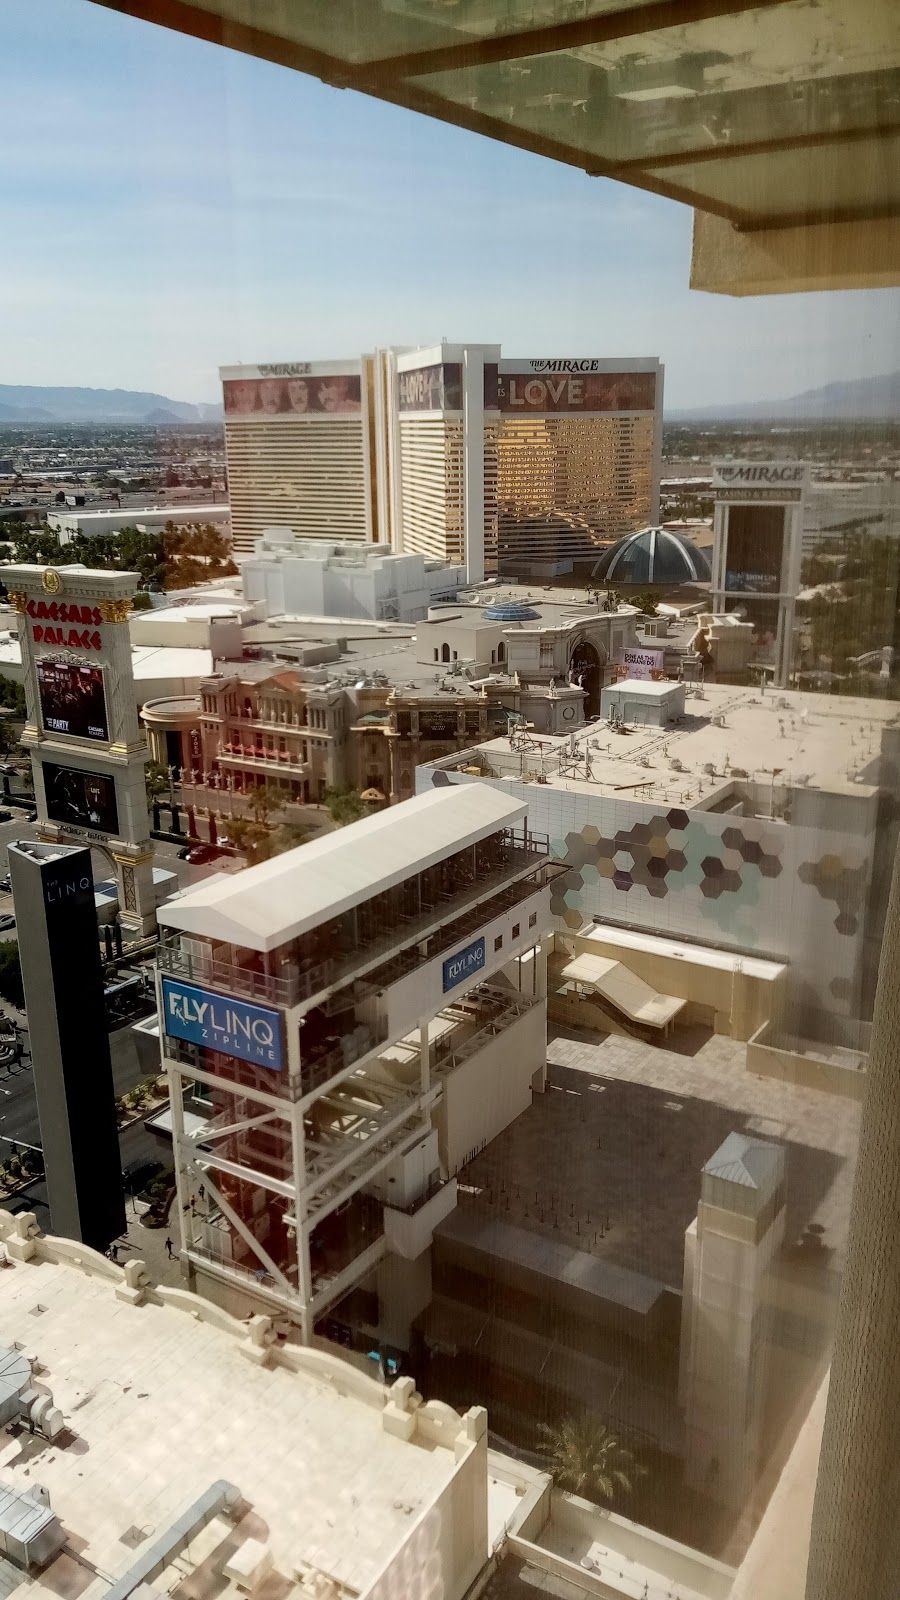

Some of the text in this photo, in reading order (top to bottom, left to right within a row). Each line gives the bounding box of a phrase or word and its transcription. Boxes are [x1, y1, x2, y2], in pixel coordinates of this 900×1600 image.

[535, 360, 598, 372] MIRAGE
[509, 380, 584, 405] LOVE
[26, 600, 103, 626] CAESARS
[33, 625, 102, 650] PALACE
[53, 719, 69, 731] PARTY
[47, 877, 89, 902] LINQ
[202, 1028, 275, 1060] ZIPLINE
